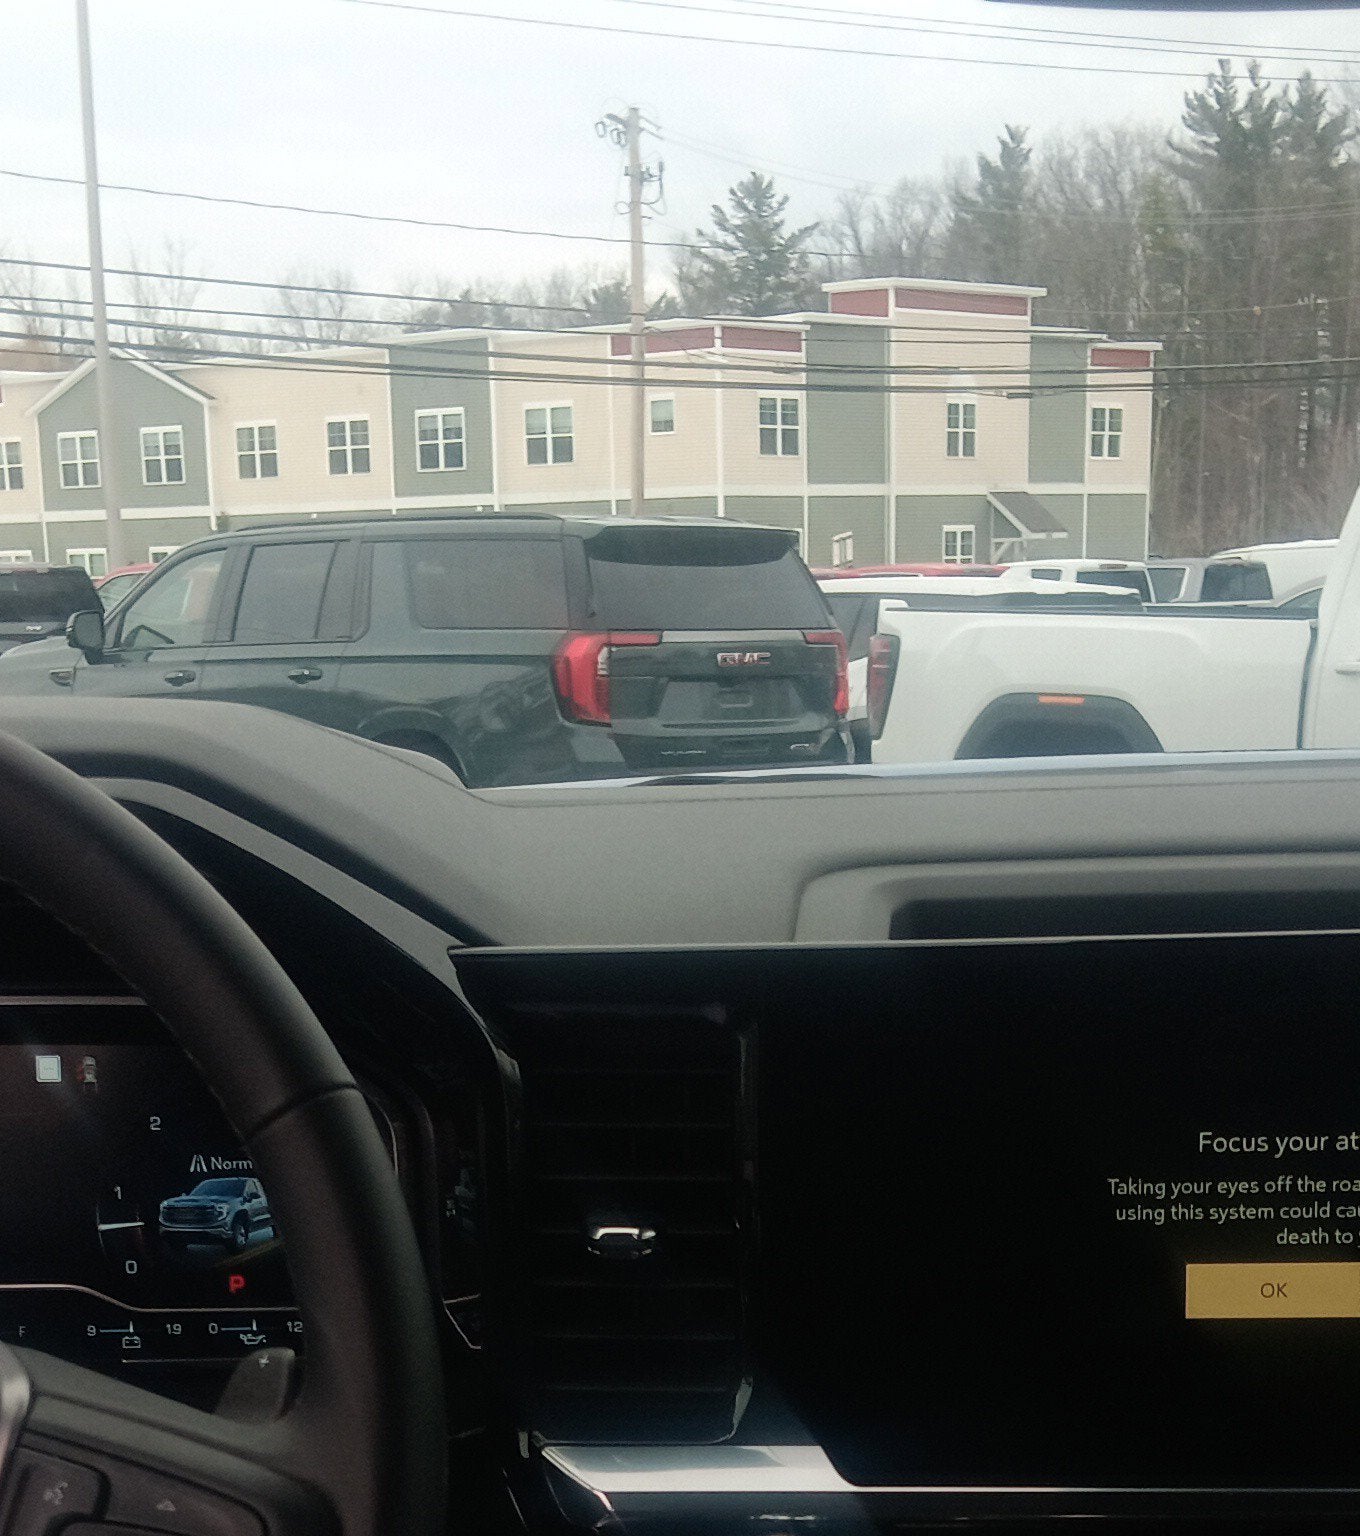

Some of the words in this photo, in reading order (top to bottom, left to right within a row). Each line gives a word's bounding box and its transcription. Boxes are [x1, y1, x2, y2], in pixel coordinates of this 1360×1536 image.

[717, 652, 772, 667] GMC
[149, 1116, 162, 1131] 2
[1198, 1131, 1269, 1153] Focus
[1274, 1135, 1329, 1159] your
[210, 1155, 254, 1171] Norm
[1107, 1177, 1166, 1199] Taking
[1170, 1181, 1213, 1200] your
[1216, 1180, 1260, 1199] eyes
[1263, 1174, 1293, 1194] off
[1296, 1174, 1327, 1193] the
[1115, 1204, 1165, 1226] using
[1170, 1203, 1205, 1221] this
[1209, 1203, 1275, 1224] system
[1279, 1200, 1331, 1219] could
[1275, 1226, 1330, 1245] death
[1334, 1228, 1354, 1245] to
[125, 1260, 138, 1275] 0
[230, 1275, 245, 1292] P
[1259, 1281, 1288, 1300] OK
[86, 1324, 97, 1337] 9
[165, 1323, 183, 1335] 19
[208, 1323, 219, 1335] 0
[286, 1321, 304, 1333] 12
